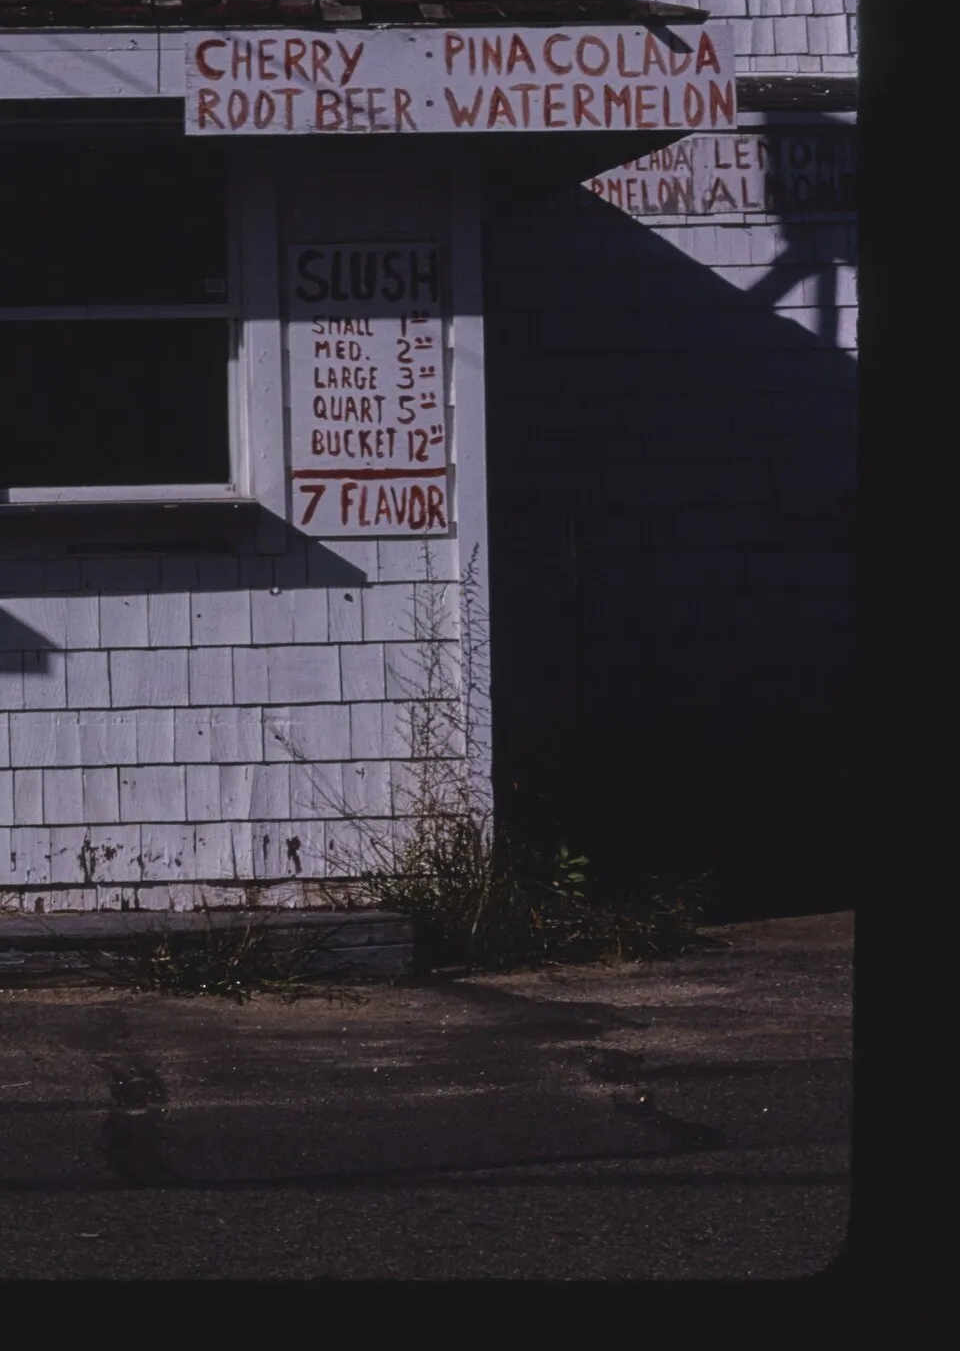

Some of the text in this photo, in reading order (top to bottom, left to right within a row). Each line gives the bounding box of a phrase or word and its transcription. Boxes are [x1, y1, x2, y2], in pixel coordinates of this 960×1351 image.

[195, 37, 364, 86] CHERRY
[197, 87, 418, 132] ROOT BEER
[444, 79, 735, 129] WATERMELON
[295, 249, 439, 303] SLUSH
[312, 314, 374, 337] SMALL
[315, 340, 371, 362] MED.
[314, 366, 378, 390] LARGE
[313, 395, 386, 424] QUART
[311, 427, 397, 458] BUCKET
[299, 482, 447, 530] 7 FLAVOR
